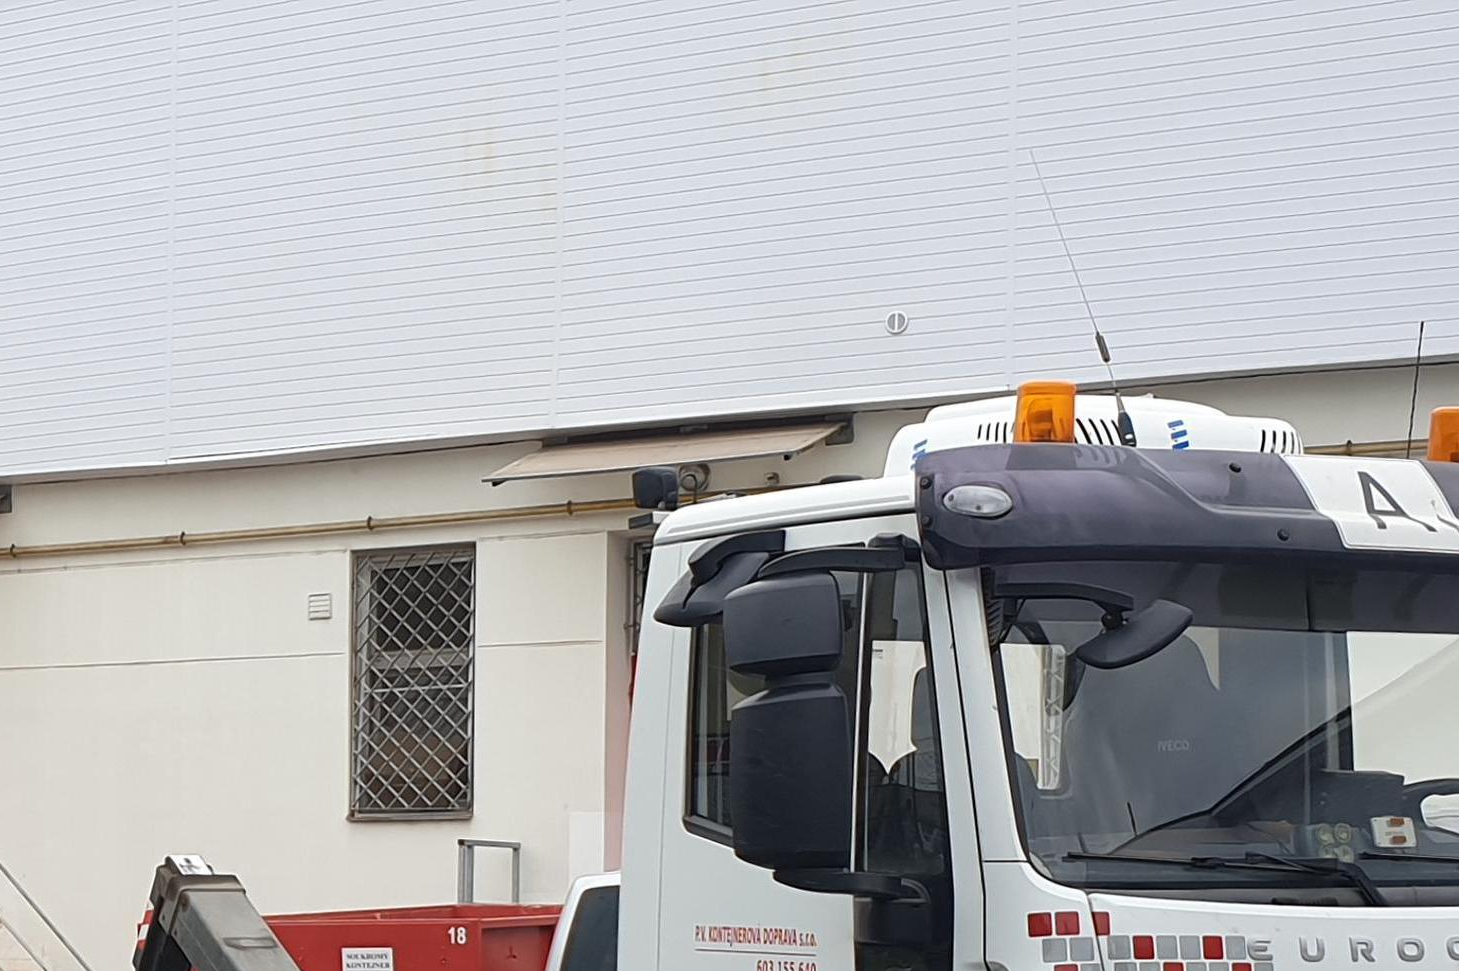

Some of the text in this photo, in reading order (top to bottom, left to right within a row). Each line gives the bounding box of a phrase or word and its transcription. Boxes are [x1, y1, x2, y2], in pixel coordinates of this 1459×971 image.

[447, 926, 467, 945] 18
[763, 927, 798, 946] DOPRAVA
[799, 932, 817, 946] s.r.o.
